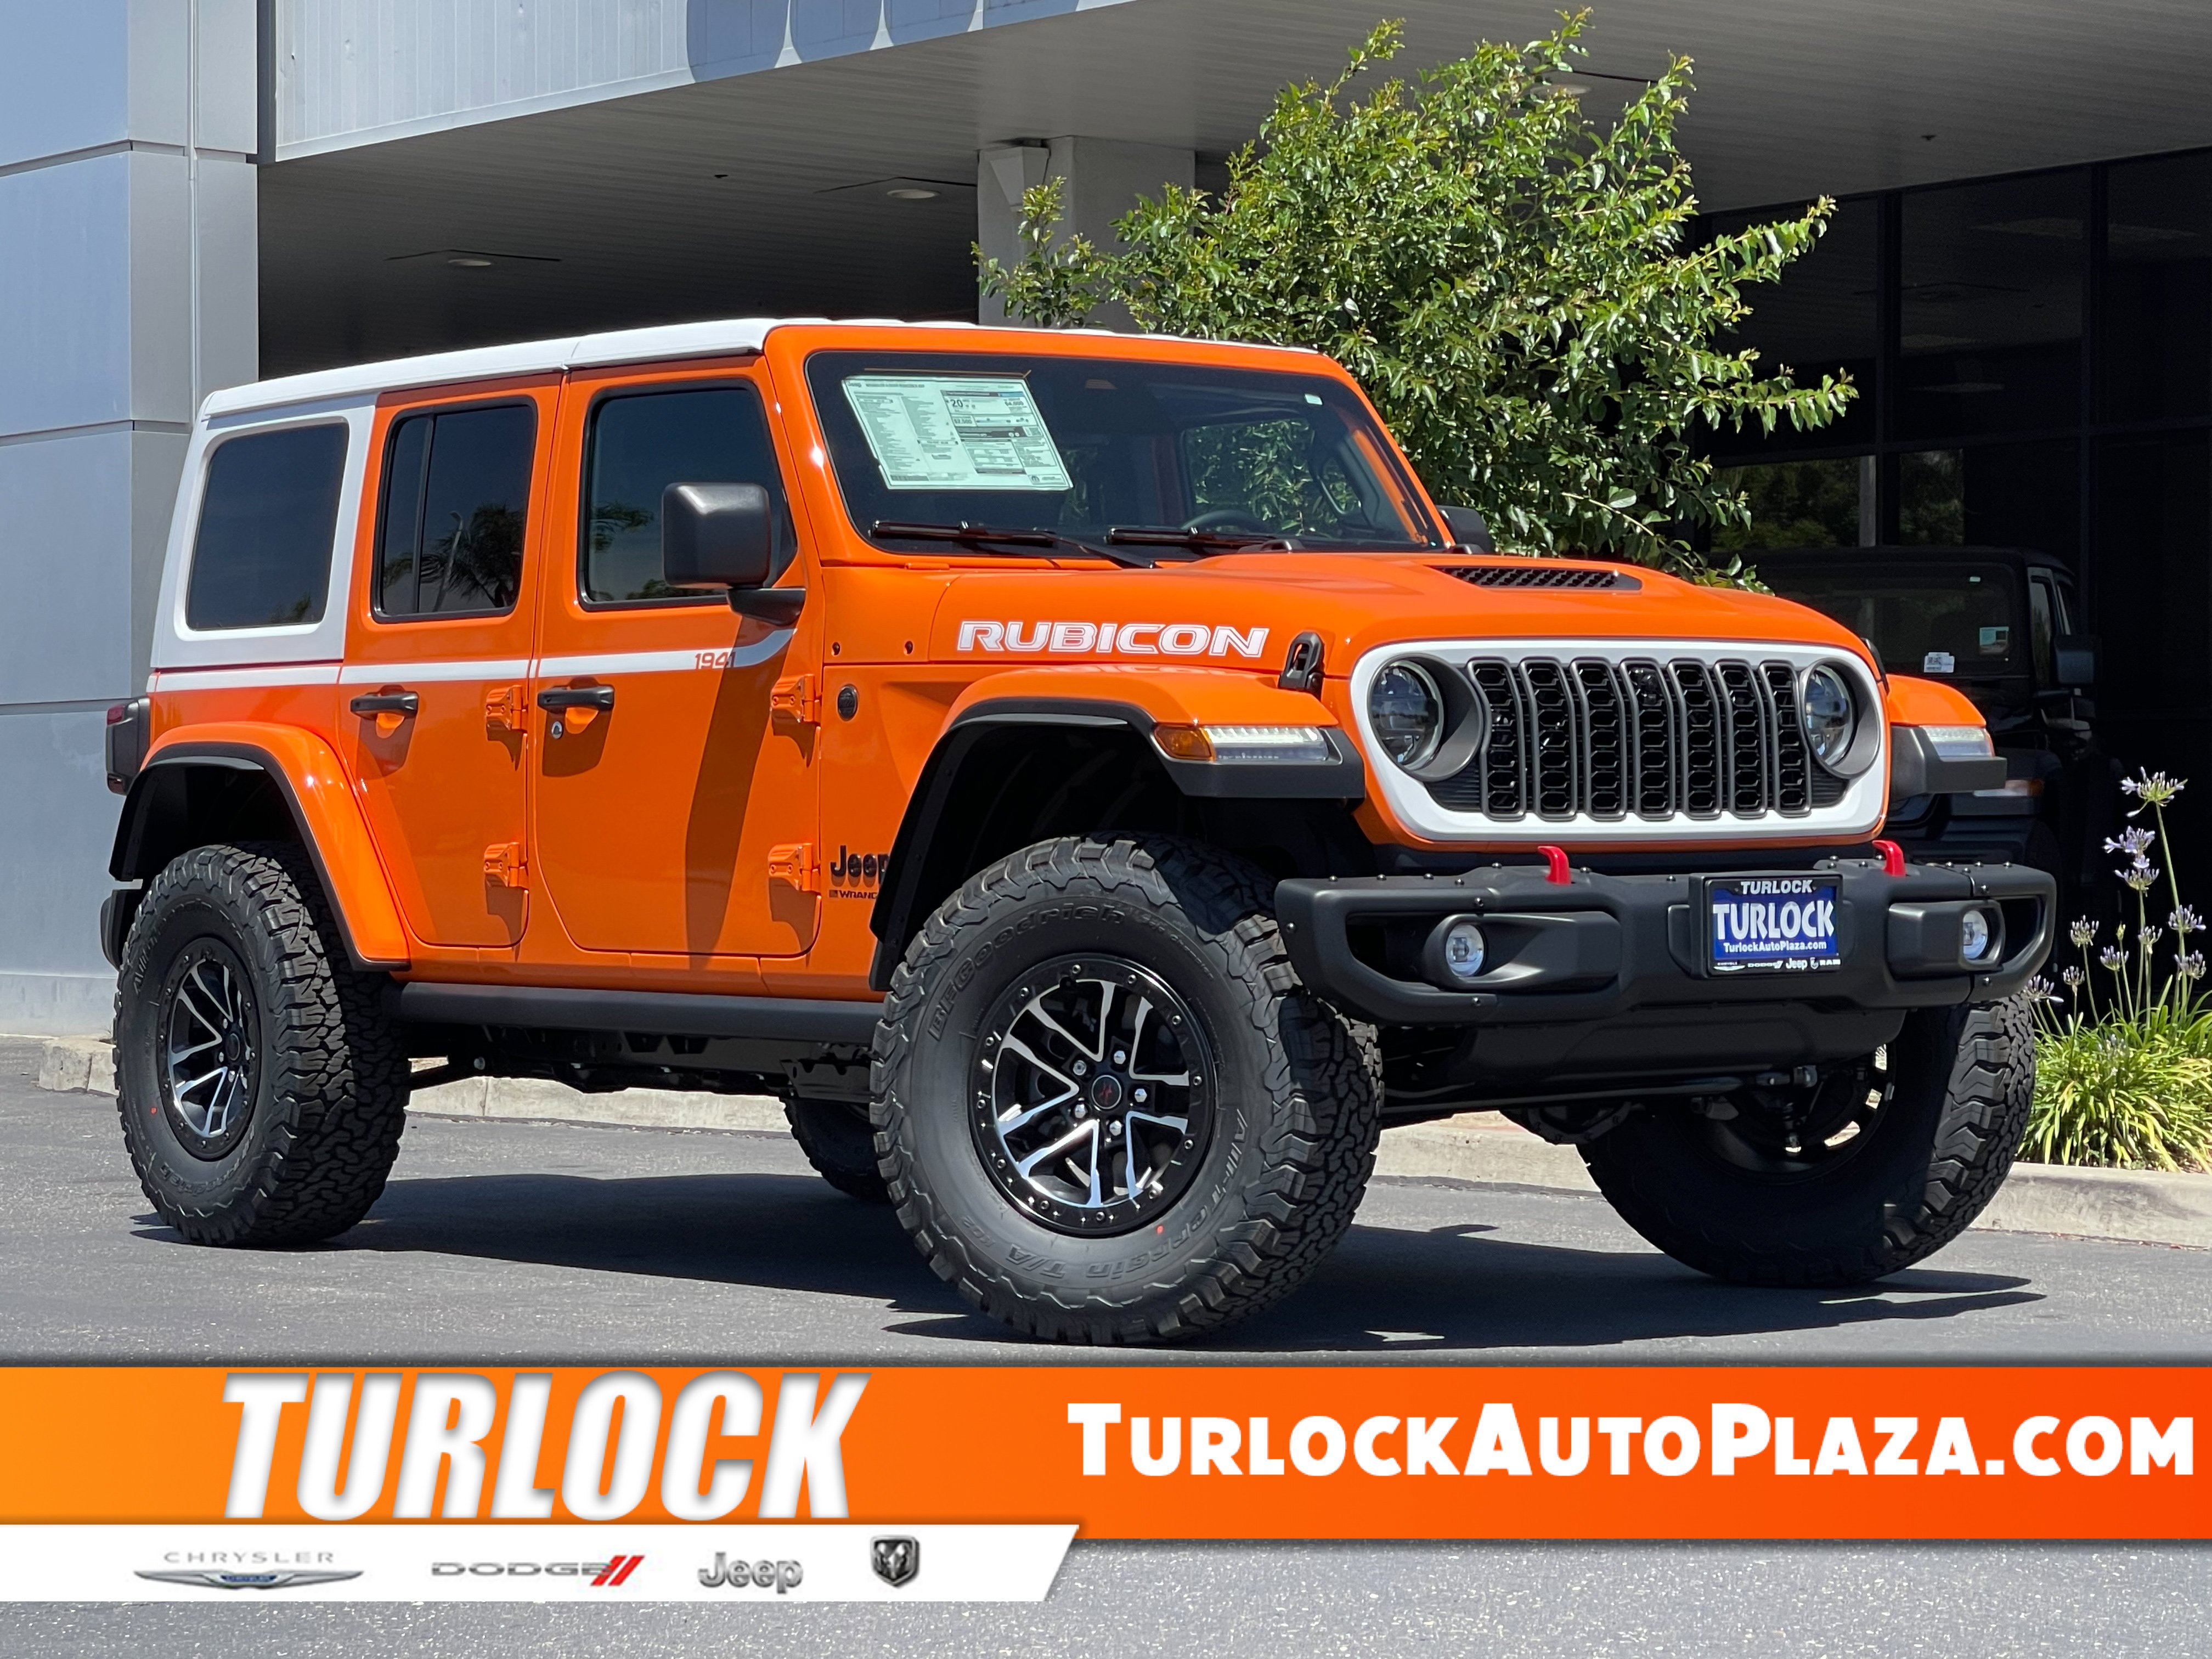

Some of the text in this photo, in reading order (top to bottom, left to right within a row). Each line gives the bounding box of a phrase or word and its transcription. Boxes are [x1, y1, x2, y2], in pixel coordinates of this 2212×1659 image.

[950, 399, 963, 408] 20
[957, 621, 1269, 657] RUBICON
[695, 652, 736, 670] 1941
[1741, 879, 1813, 894] TURLOCK
[1713, 900, 1835, 940] TURLOCK
[1723, 940, 1827, 953] TurlockAutoPlaza.com
[928, 902, 1126, 1041] BFGoodrich
[1786, 957, 1808, 970] Jeep
